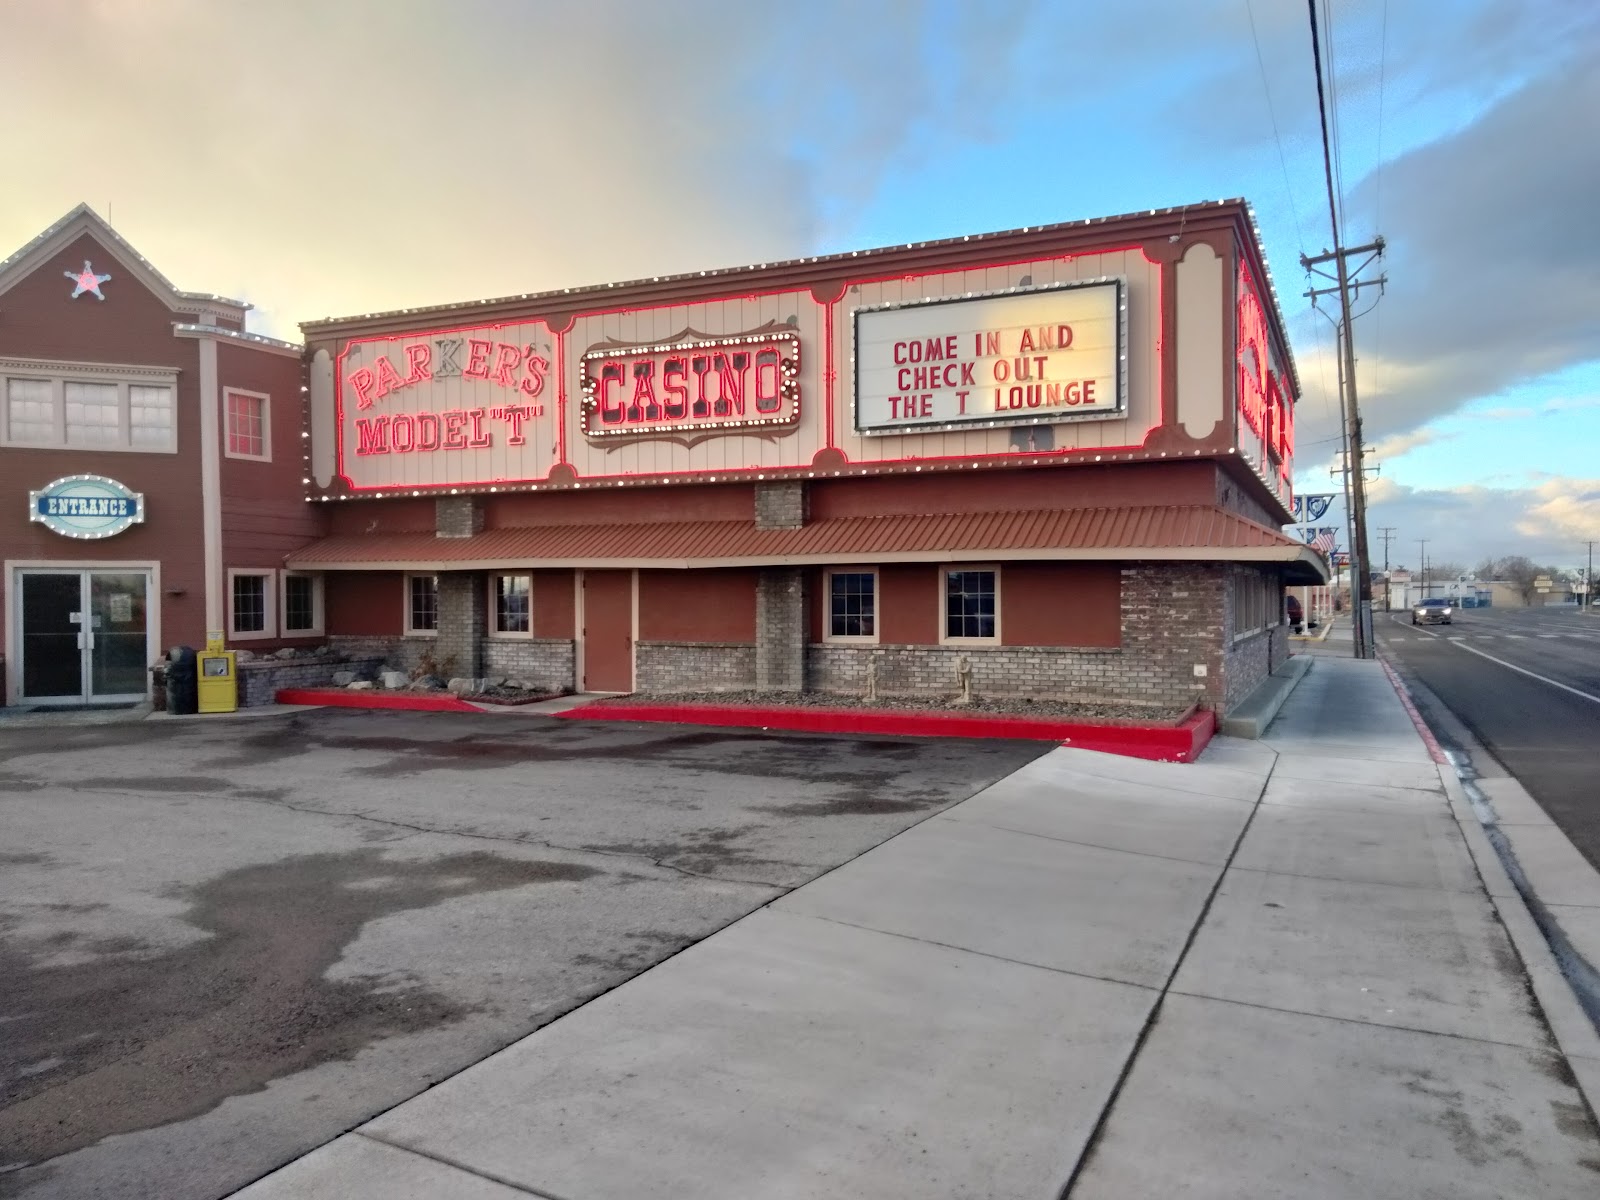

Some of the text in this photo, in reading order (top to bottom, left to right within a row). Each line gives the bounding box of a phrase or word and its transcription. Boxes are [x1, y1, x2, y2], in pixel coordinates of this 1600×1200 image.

[894, 325, 1073, 365] COME IN AND
[347, 338, 549, 410] PARKER'S
[600, 347, 782, 424] CASINO
[898, 356, 1049, 391] CHECK OUT
[888, 380, 1096, 420] THE T LOUNGE
[355, 408, 492, 456] MODEL
[48, 498, 127, 516] ENTRANCE
